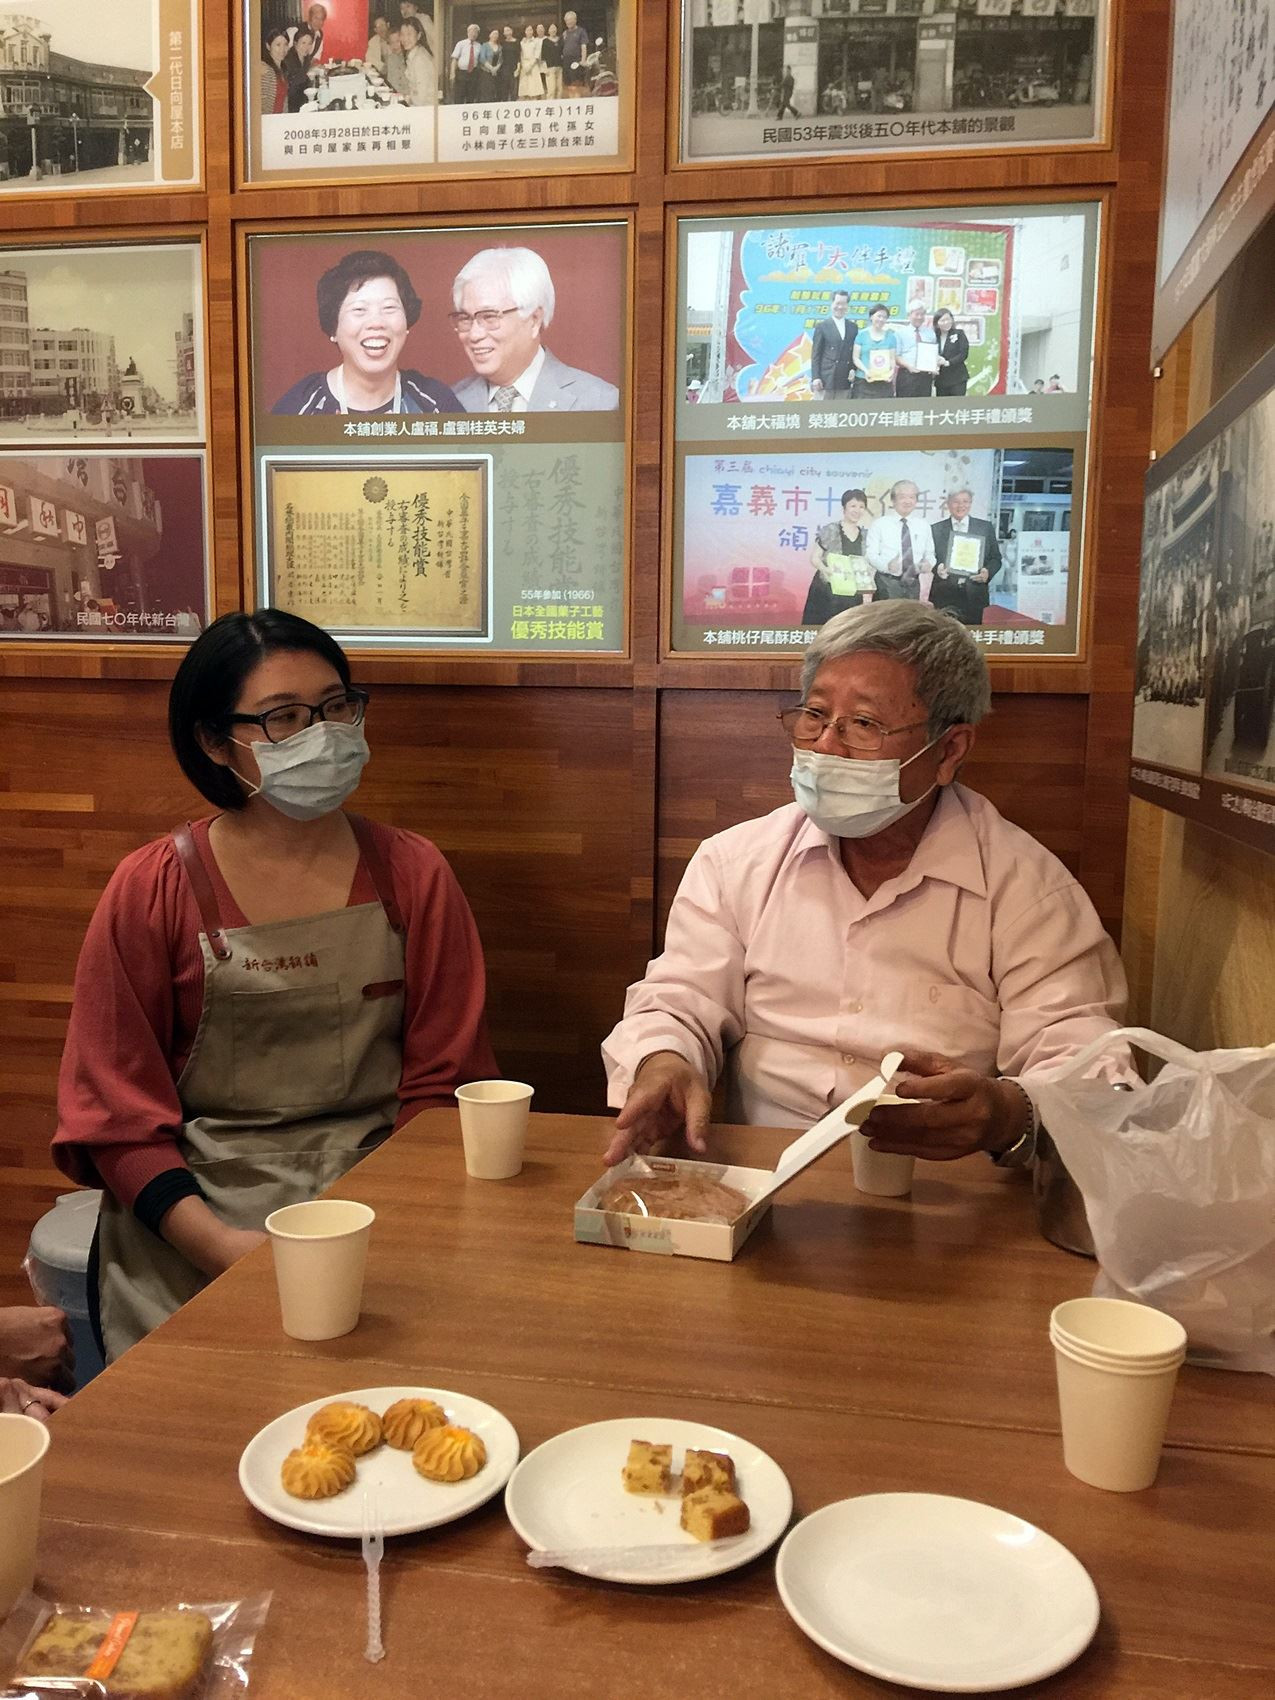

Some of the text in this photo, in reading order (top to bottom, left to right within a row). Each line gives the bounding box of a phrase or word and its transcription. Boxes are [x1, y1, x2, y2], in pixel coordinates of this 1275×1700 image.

[283, 124, 411, 141] 2008年3月28日於日本九州
[462, 120, 595, 137] 日向屋第四代孫女
[799, 466, 822, 478] city
[411, 491, 433, 578] 優秀技能賞
[563, 589, 595, 601] (1966)
[511, 620, 604, 640] 優秀技能賞
